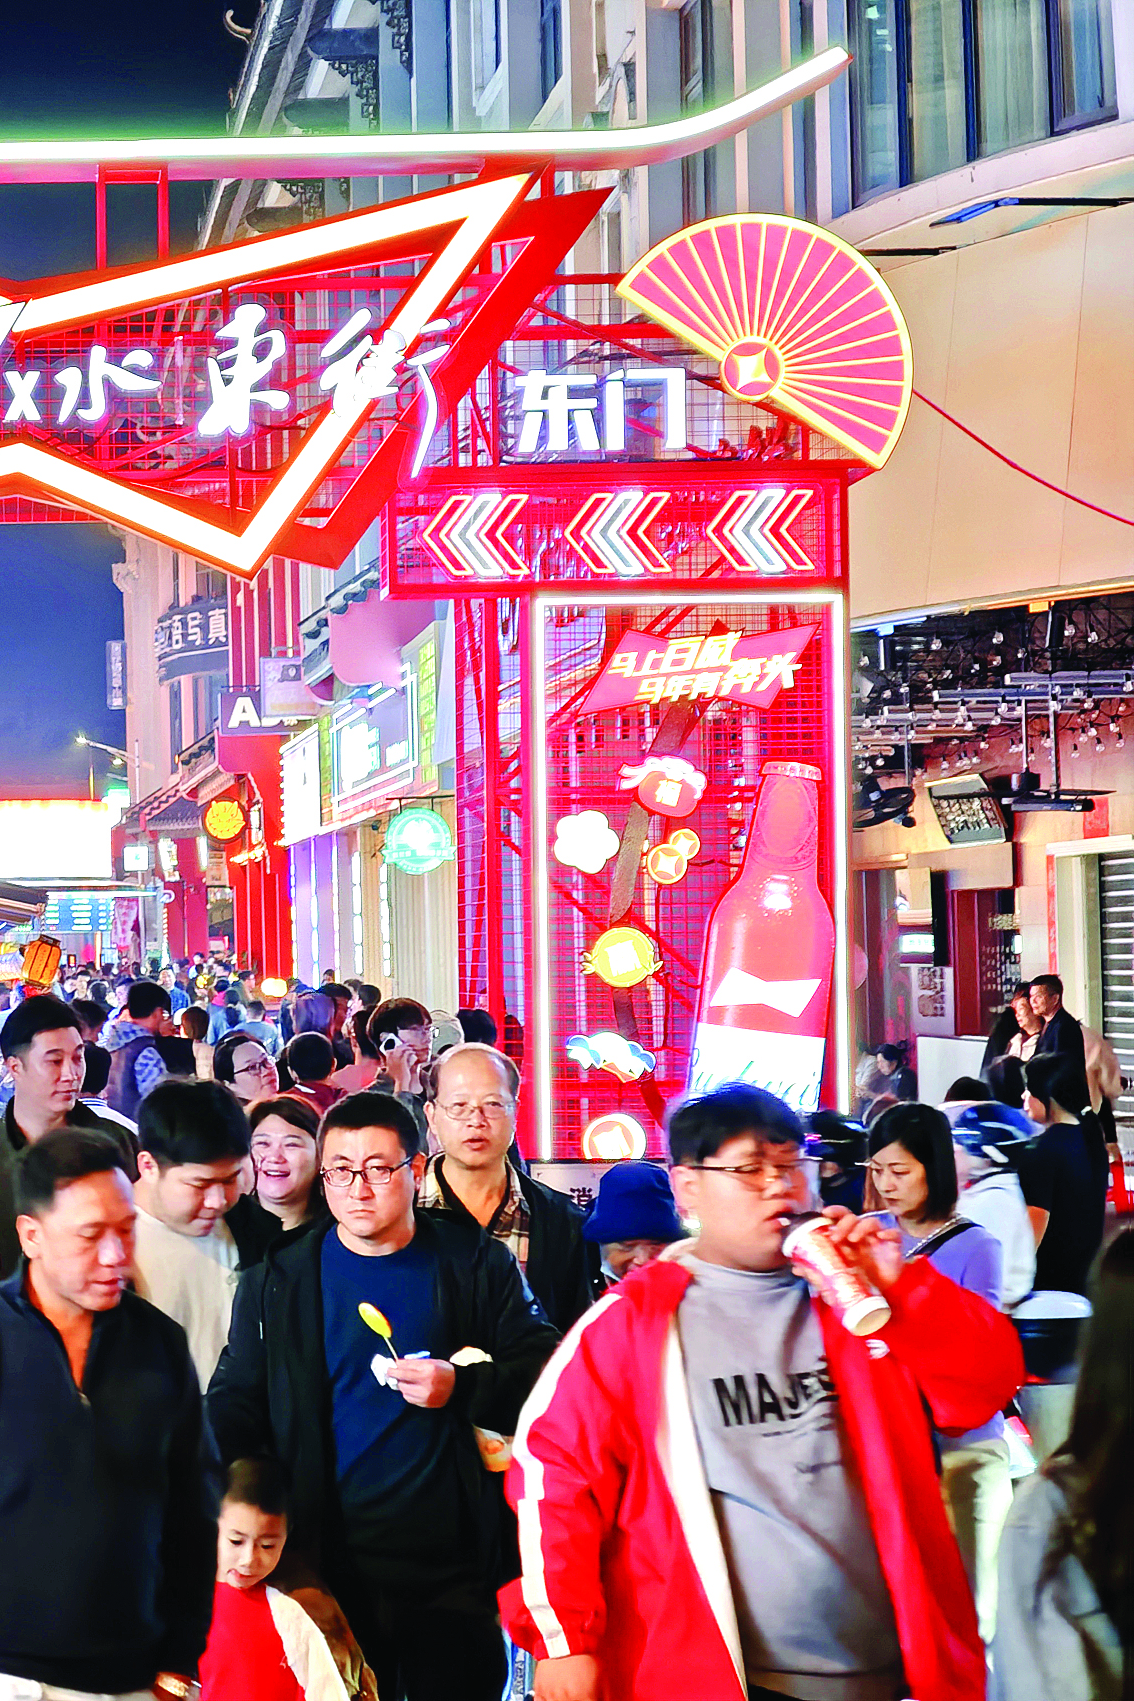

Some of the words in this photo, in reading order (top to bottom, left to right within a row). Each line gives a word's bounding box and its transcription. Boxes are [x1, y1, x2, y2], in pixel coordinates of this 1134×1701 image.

[515, 367, 687, 453] 东门
[634, 651, 803, 705] 马年有奔头
